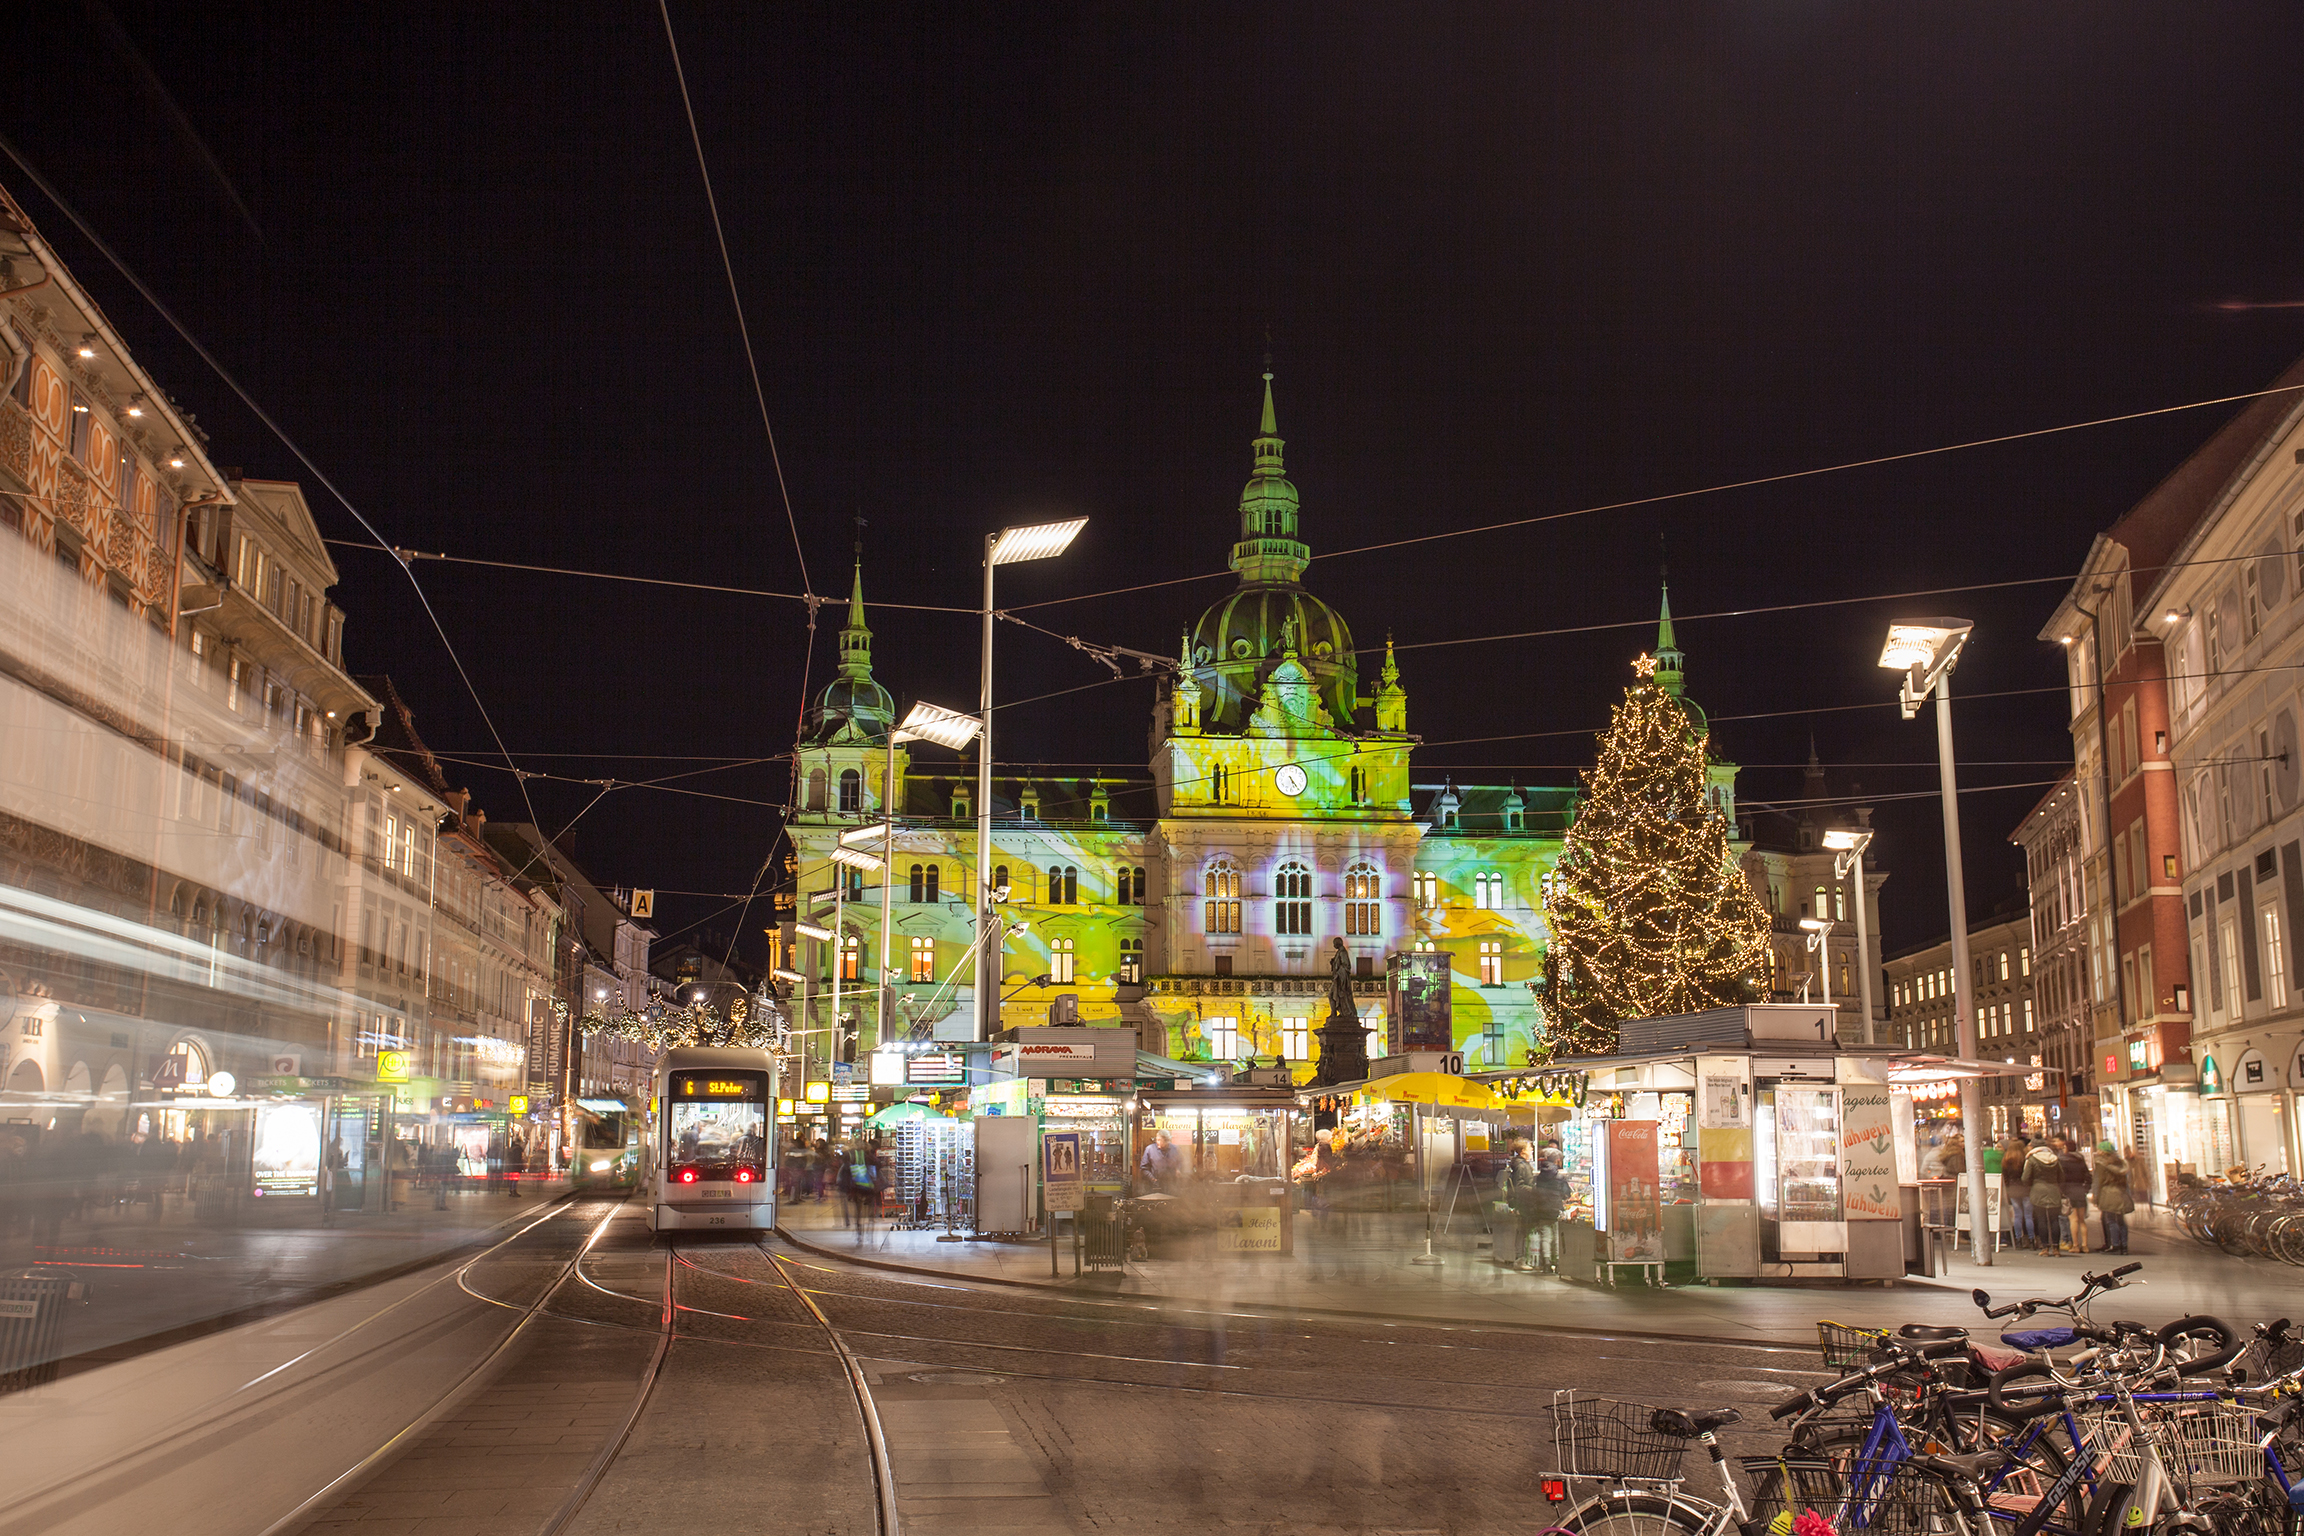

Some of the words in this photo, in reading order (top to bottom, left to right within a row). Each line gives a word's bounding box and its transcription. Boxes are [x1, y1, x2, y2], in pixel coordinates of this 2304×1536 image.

[635, 896, 649, 913] A
[1815, 1018, 1824, 1040] 1
[531, 1016, 544, 1072] HUMANIC
[548, 1024, 560, 1076] HUMANIC
[1020, 1045, 1073, 1055] MORAWA
[1440, 1055, 1461, 1075] 10
[1273, 1074, 1287, 1084] 14
[686, 1081, 694, 1094] 6
[709, 1081, 743, 1093] St.Peter
[1842, 1088, 1889, 1112] agertee
[1158, 1120, 1192, 1129] Maroni
[1219, 1121, 1253, 1129] Maroni
[1248, 1218, 1278, 1230] Heiße
[1221, 1234, 1278, 1248] Maroni
[2047, 1441, 2097, 1507] GENESIS
